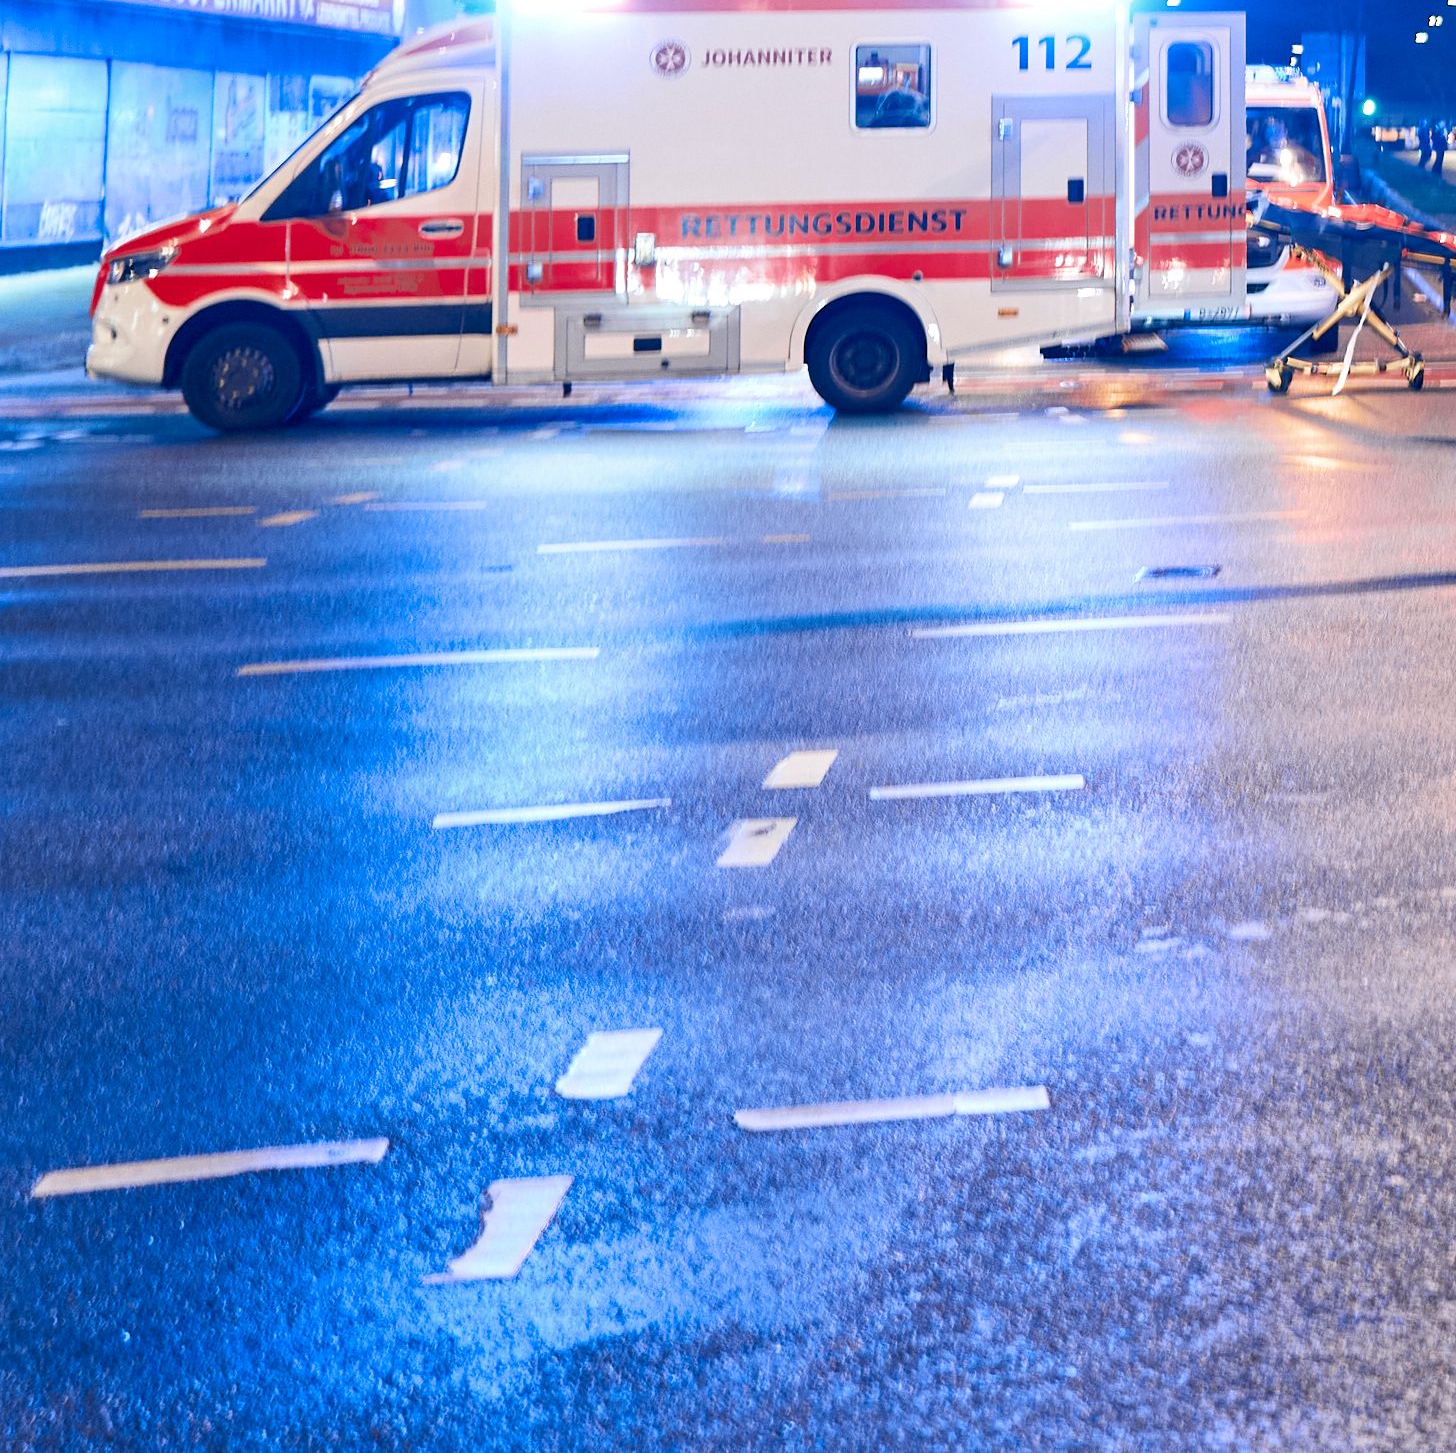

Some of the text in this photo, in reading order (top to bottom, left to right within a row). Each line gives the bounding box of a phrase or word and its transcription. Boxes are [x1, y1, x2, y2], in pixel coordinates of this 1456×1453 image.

[702, 47, 833, 67] JOHANNITER
[1011, 34, 1093, 72] 112
[681, 210, 967, 238] RETTUNGSDIENST
